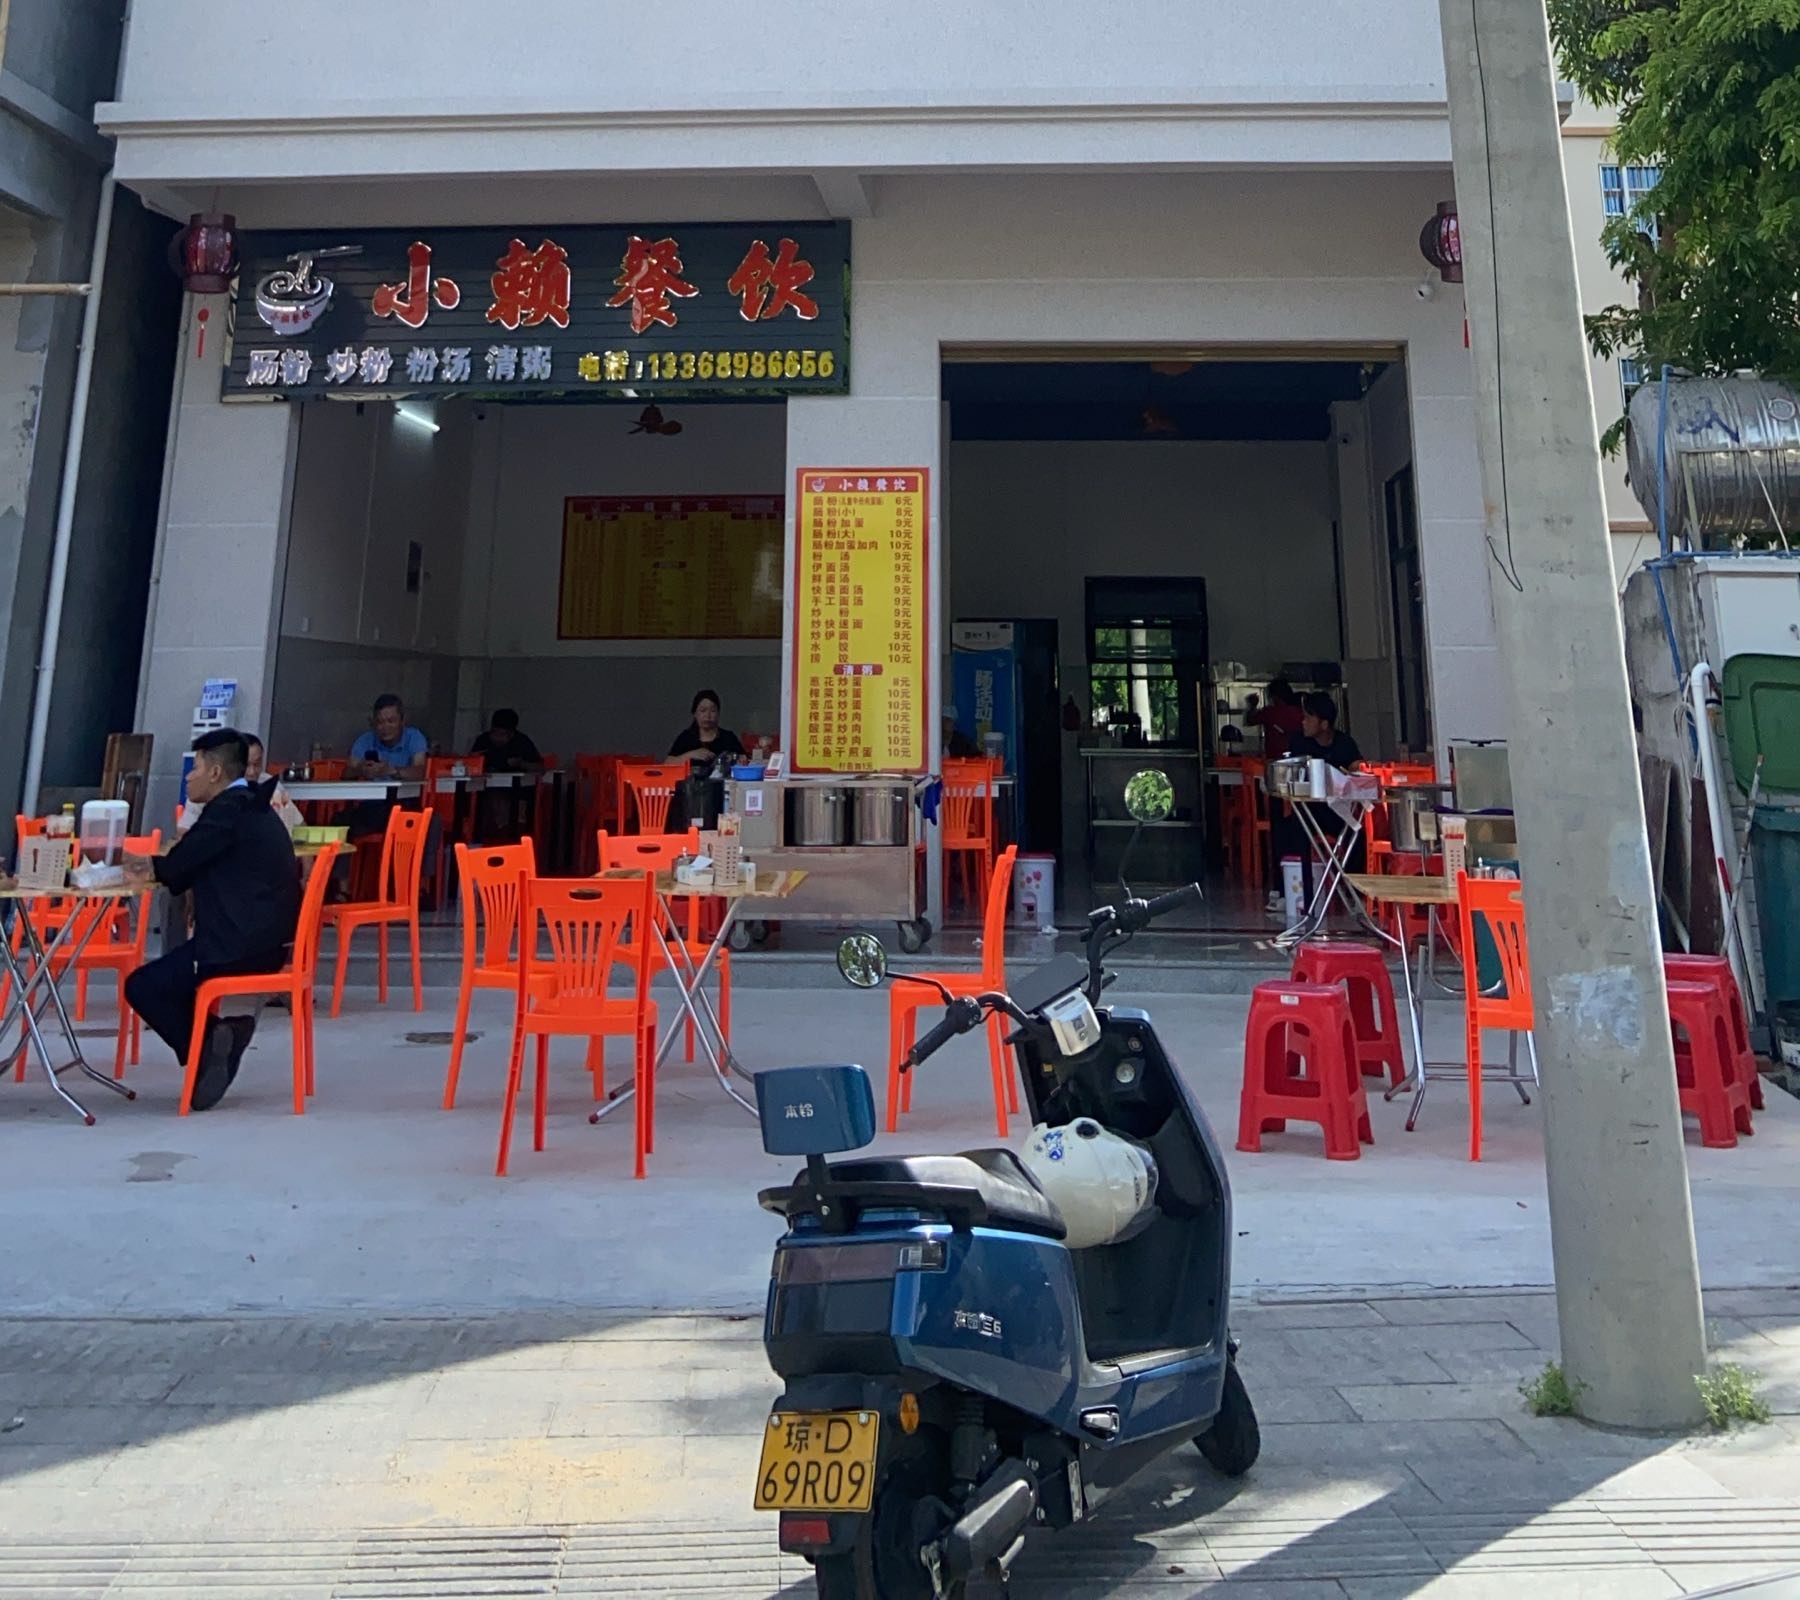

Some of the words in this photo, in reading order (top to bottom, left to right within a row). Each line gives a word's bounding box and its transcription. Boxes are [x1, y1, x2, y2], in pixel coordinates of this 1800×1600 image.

[246, 349, 312, 385] 肠粉
[324, 347, 393, 384] 炒粉
[406, 346, 471, 383] 粉汤
[485, 345, 552, 382] 清粥
[889, 529, 912, 539] 10元
[889, 540, 912, 550] 10元
[888, 642, 911, 652] 10元
[888, 653, 911, 663] 10元
[888, 688, 911, 699] 10元
[888, 700, 911, 710] 10元
[888, 736, 911, 745] 10元
[888, 747, 911, 758] 10元
[784, 1418, 852, 1453] 琼·D
[762, 1461, 865, 1503] 69R09
